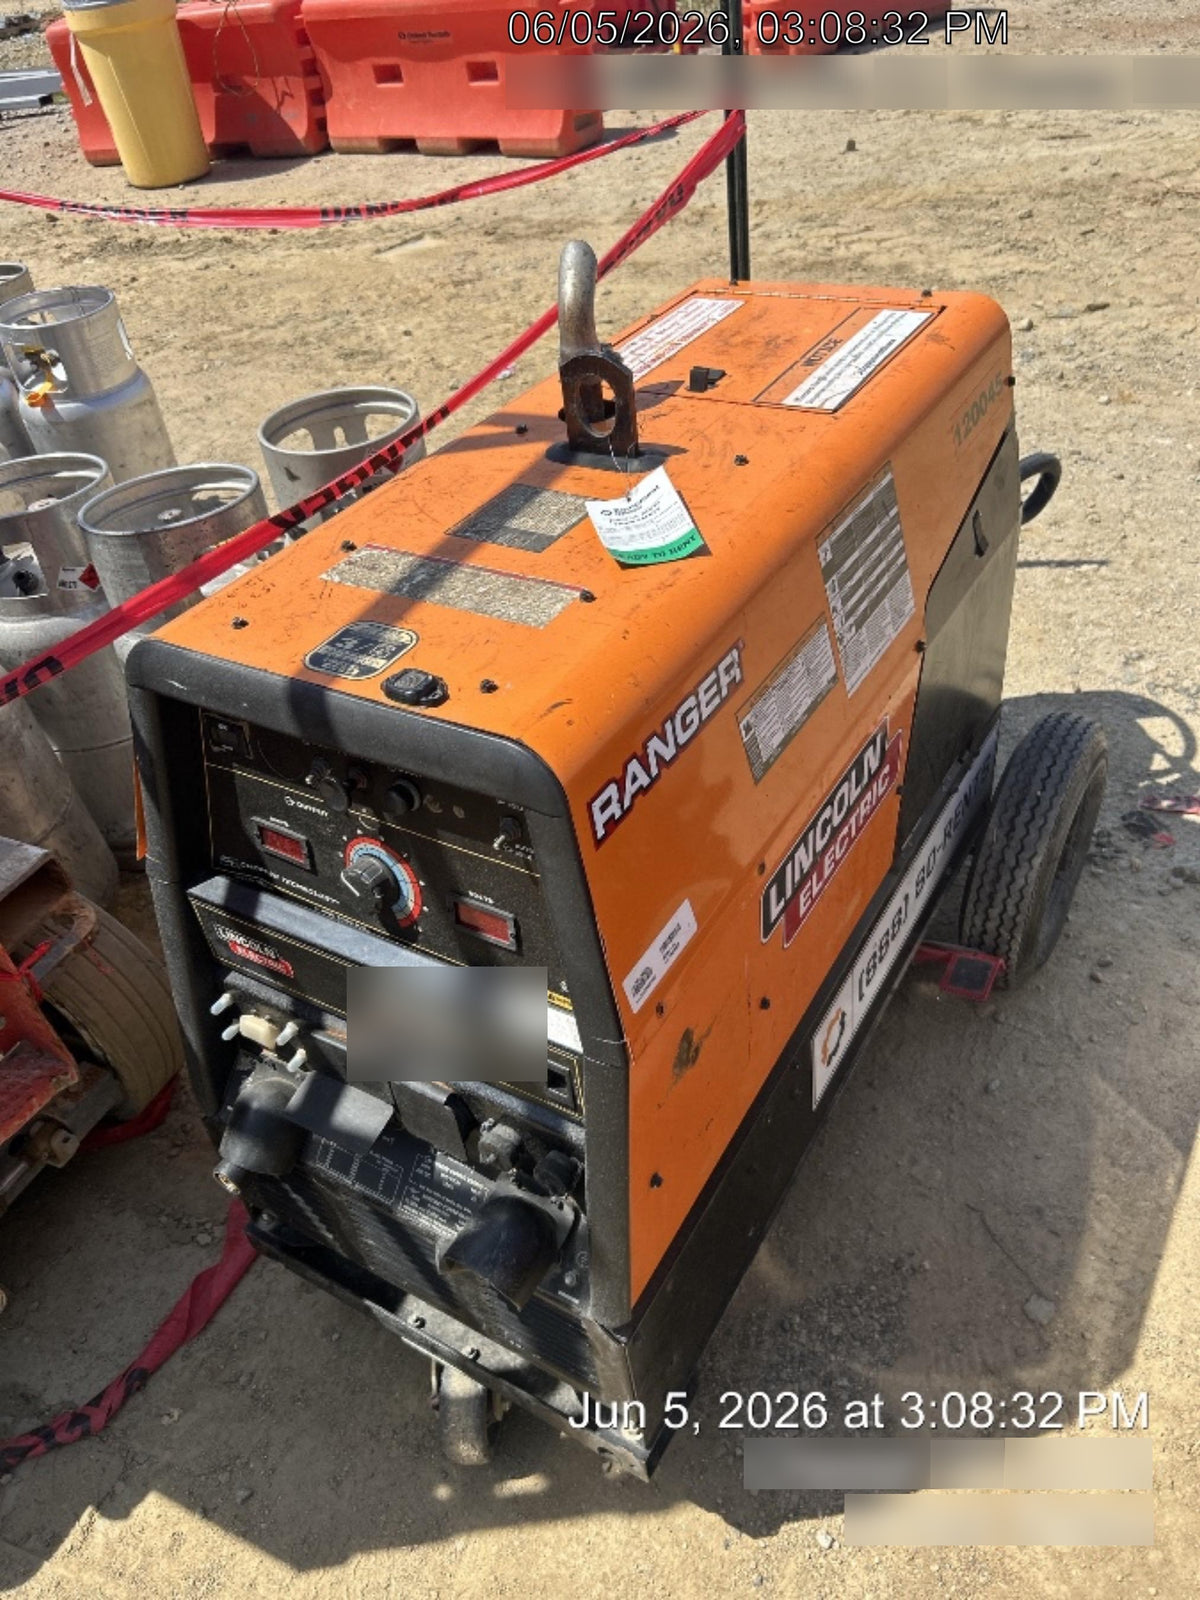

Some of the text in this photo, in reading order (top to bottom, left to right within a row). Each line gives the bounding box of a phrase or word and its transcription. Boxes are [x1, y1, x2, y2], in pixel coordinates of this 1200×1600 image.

[590, 645, 742, 842] RANGER
[767, 729, 884, 925] LINCOLN
[799, 763, 891, 919] ELECTRIC
